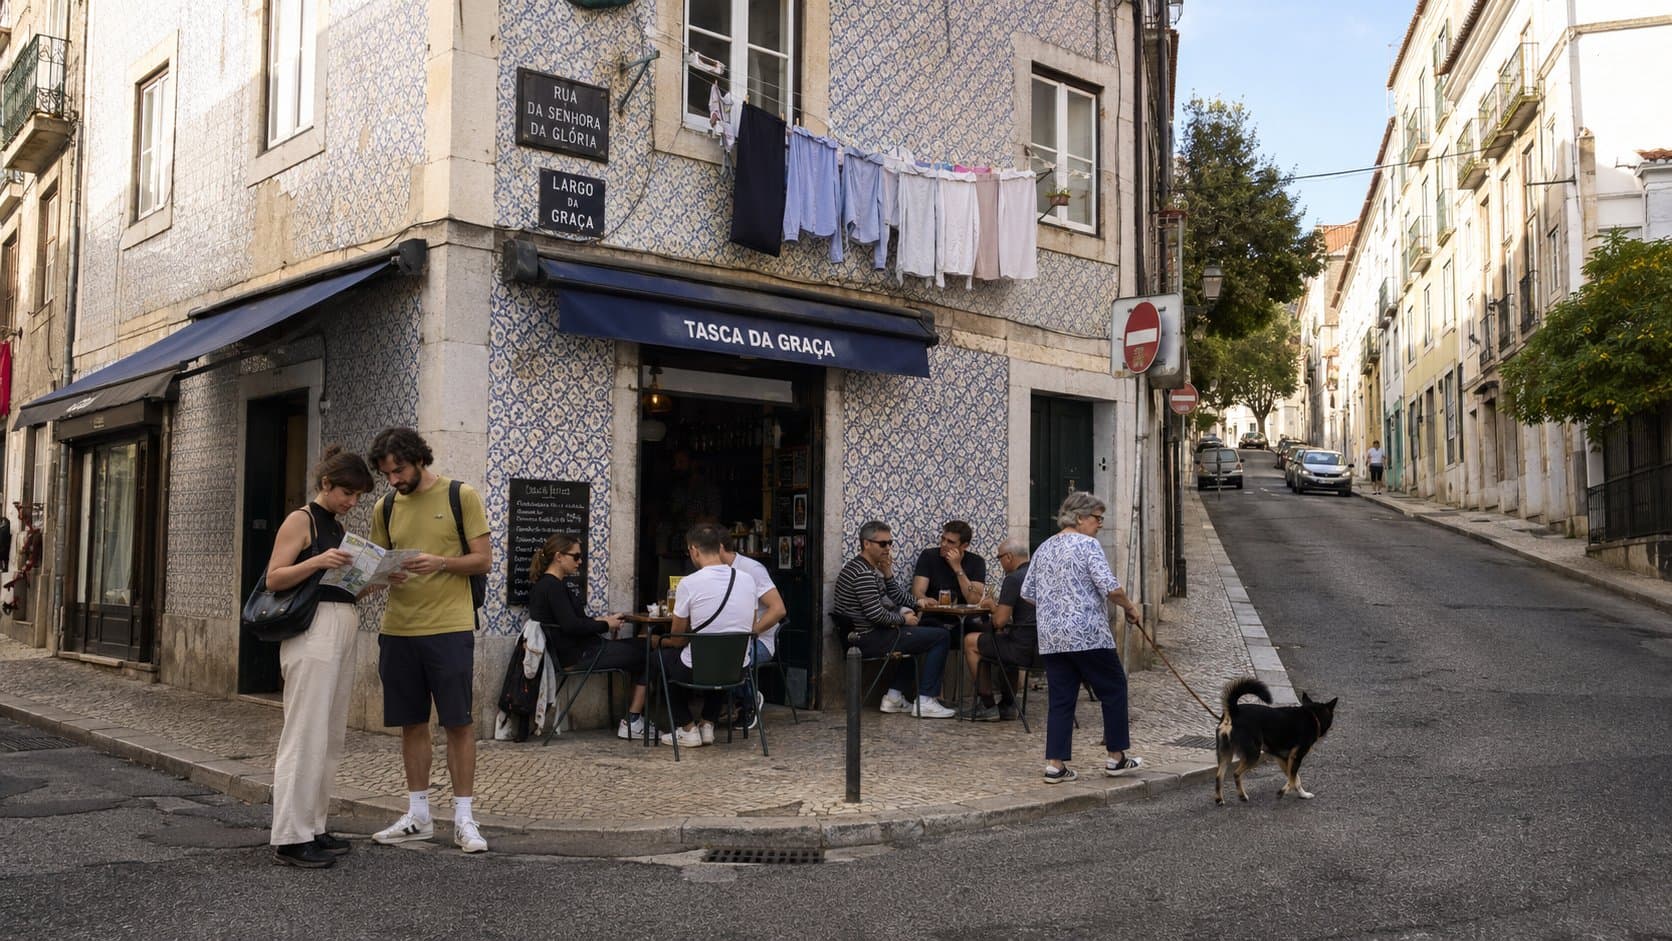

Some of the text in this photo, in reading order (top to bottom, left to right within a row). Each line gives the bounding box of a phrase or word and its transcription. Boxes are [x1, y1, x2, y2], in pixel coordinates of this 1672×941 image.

[554, 86, 577, 104] RUA
[528, 102, 601, 130] DA SENHORA
[530, 122, 597, 149] DA GLÓRIA
[552, 176, 593, 197] LARGO
[567, 197, 579, 208] DA
[551, 209, 594, 232] GRAÇA
[684, 320, 836, 360] TASCA DA GRAÇA
